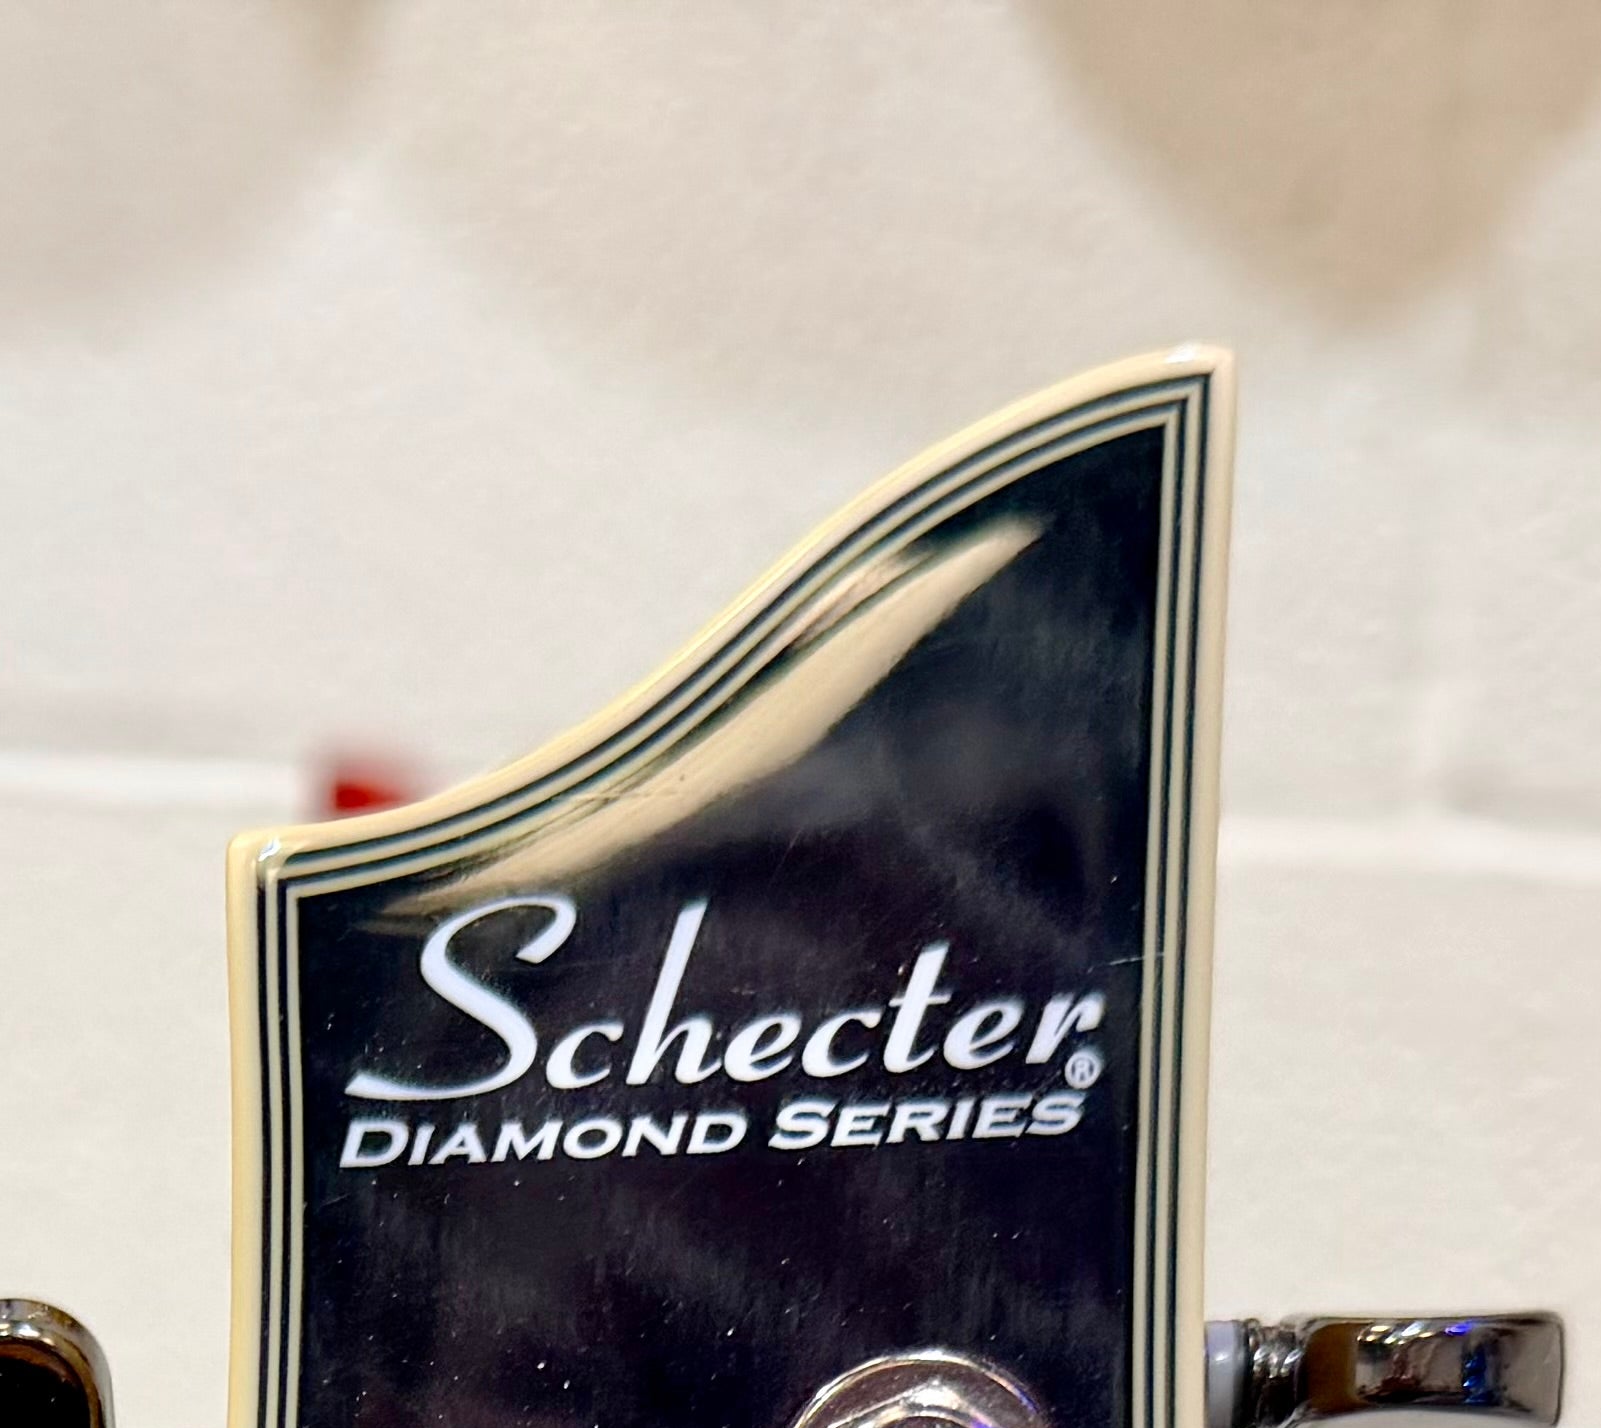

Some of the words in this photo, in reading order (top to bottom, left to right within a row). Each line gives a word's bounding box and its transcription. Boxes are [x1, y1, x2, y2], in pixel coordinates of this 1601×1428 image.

[346, 894, 1103, 1100] Schecter
[340, 1112, 748, 1168] DIAMOND
[769, 1092, 1085, 1150] SERIES
